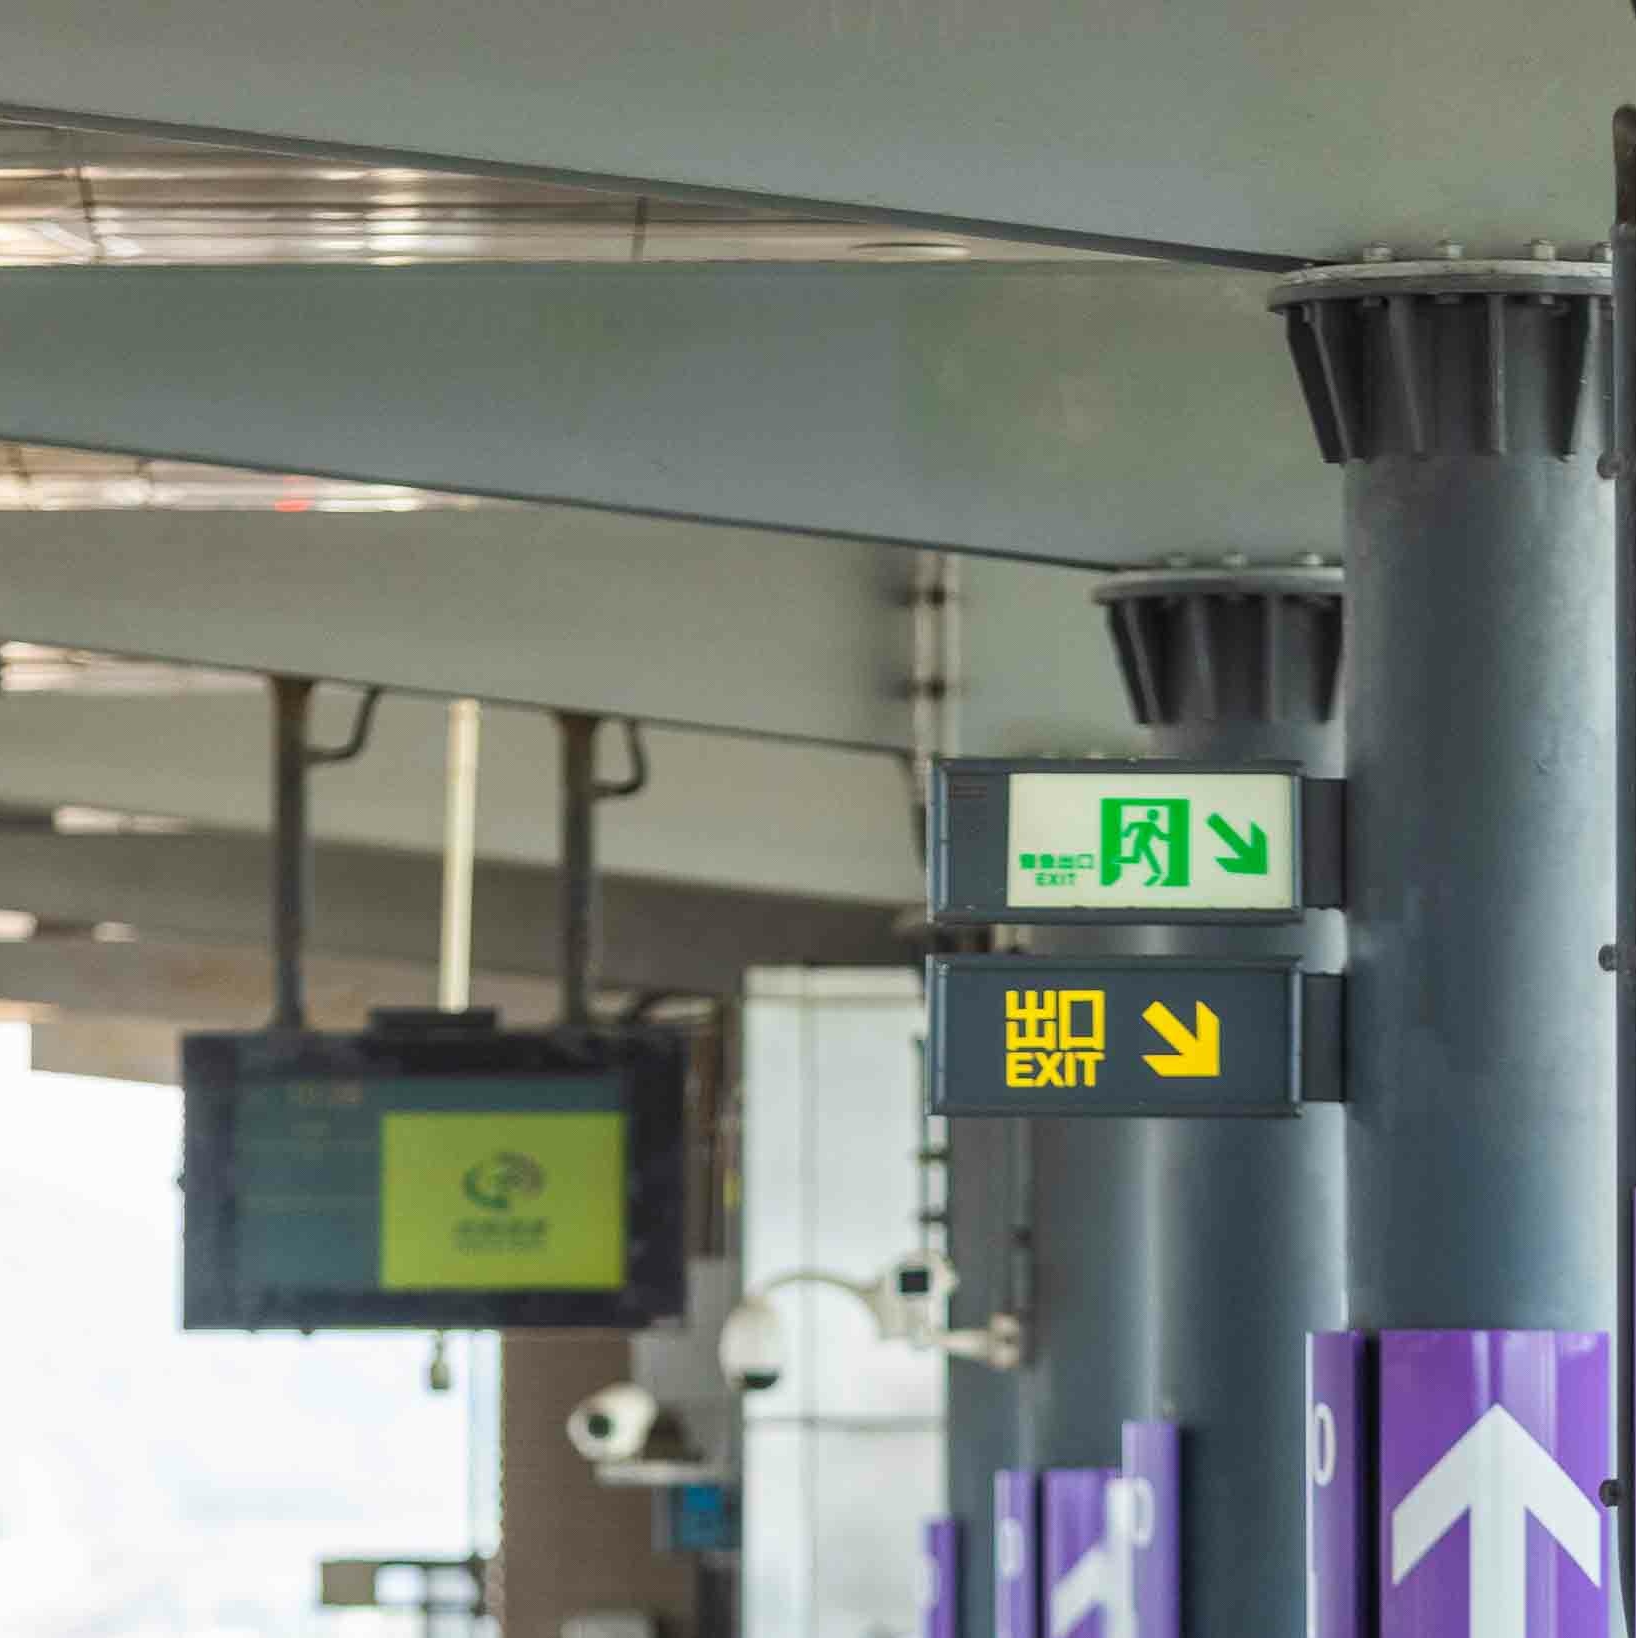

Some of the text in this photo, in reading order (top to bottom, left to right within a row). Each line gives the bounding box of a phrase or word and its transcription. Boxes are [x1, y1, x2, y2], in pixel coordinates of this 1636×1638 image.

[1035, 872, 1077, 886] EXIT
[1005, 990, 1105, 1051] 出口
[1005, 1052, 1105, 1087] EXIT
